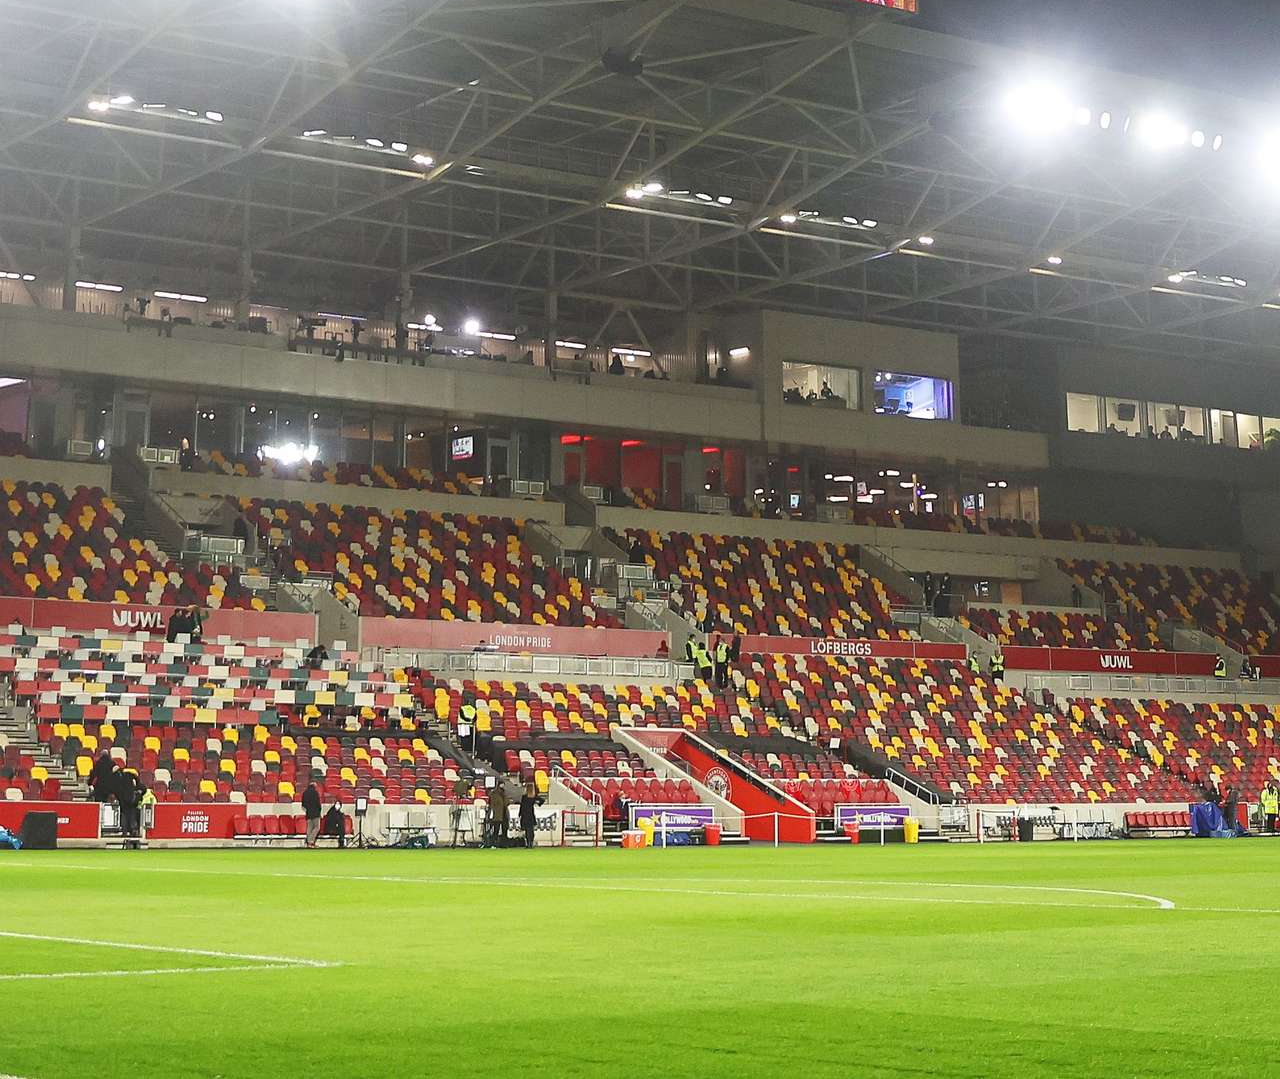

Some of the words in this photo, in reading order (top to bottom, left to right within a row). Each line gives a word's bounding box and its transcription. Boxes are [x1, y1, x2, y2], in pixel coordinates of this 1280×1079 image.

[489, 634, 525, 647] LONDON
[526, 637, 552, 648] PRIDE
[811, 638, 872, 656] LÖFBERGS
[182, 821, 209, 833] PRIDE
